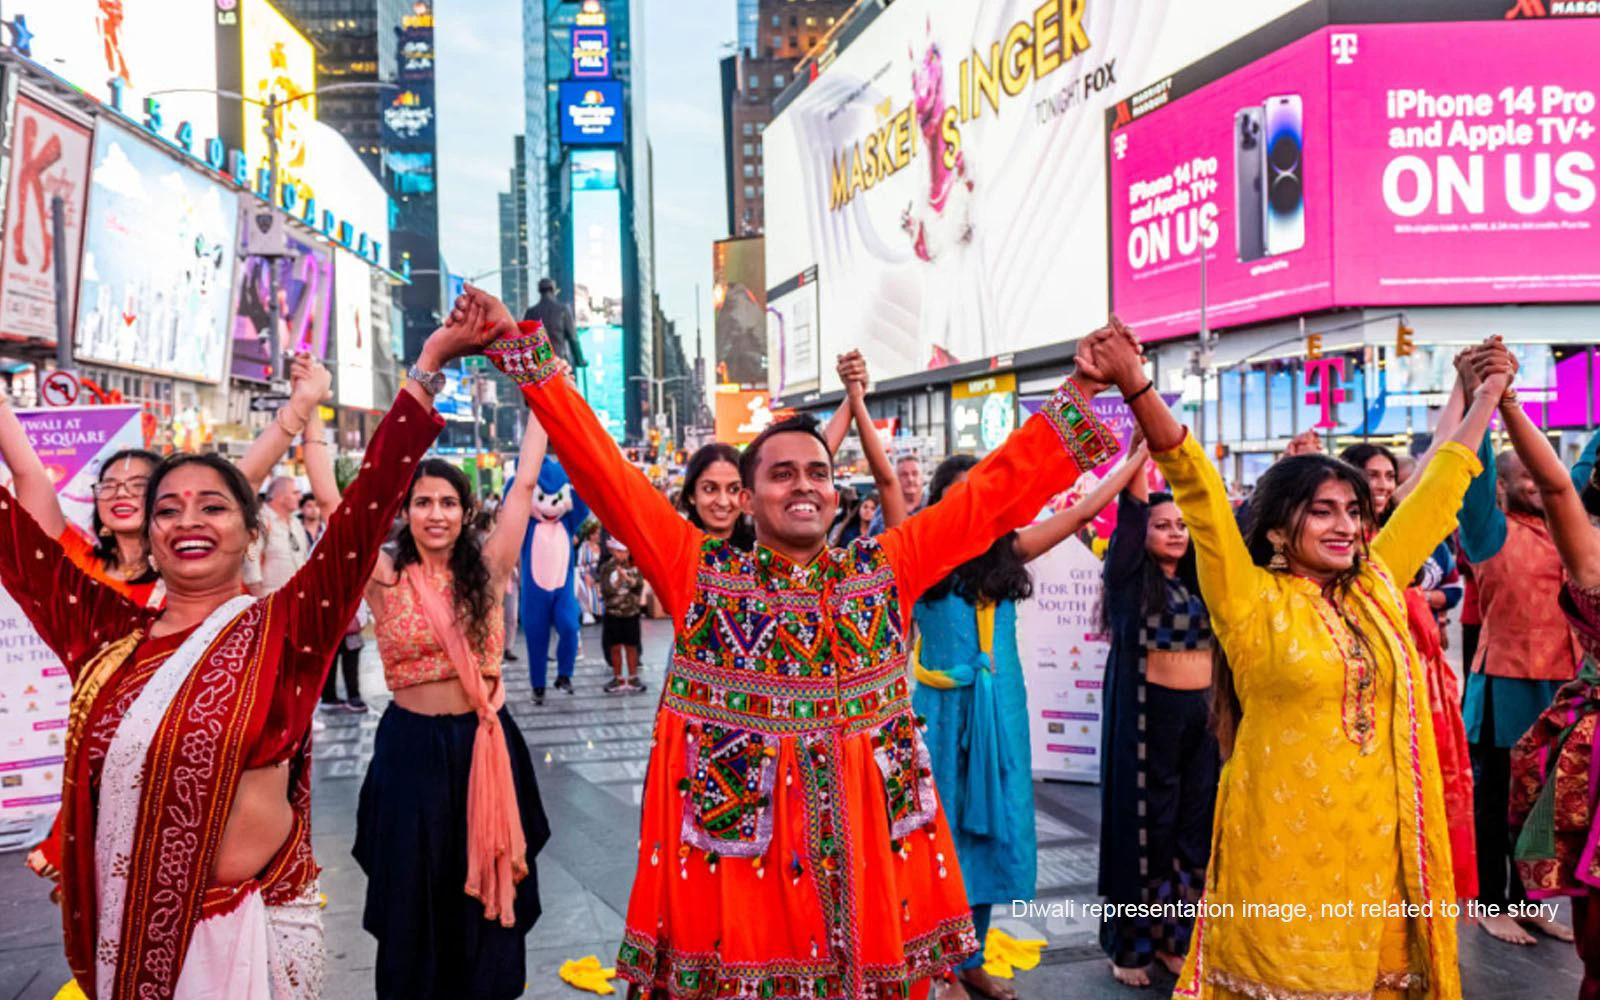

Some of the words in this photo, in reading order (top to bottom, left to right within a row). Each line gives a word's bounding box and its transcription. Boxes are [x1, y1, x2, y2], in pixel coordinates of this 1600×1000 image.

[218, 11, 236, 25] LG
[1084, 58, 1117, 99] FOX
[1386, 89, 1494, 118] iPhone
[1498, 86, 1536, 116] 14
[1541, 85, 1596, 115] Pro
[1388, 120, 1443, 148] and
[1447, 119, 1534, 152] Apple
[1536, 116, 1596, 144] TV+
[1129, 174, 1173, 205] iPhone
[1192, 156, 1218, 180] Pro
[1382, 154, 1485, 217] ON
[1504, 150, 1597, 215] US
[1129, 200, 1153, 224] and
[1153, 188, 1190, 217] Apple
[1128, 217, 1170, 269] ON
[1176, 201, 1219, 255] US
[23, 419, 62, 431] IWALI
[65, 417, 81, 430] AT
[1114, 403, 1129, 414] AT
[41, 430, 105, 448] SQUARE
[0, 635, 43, 649] UTH
